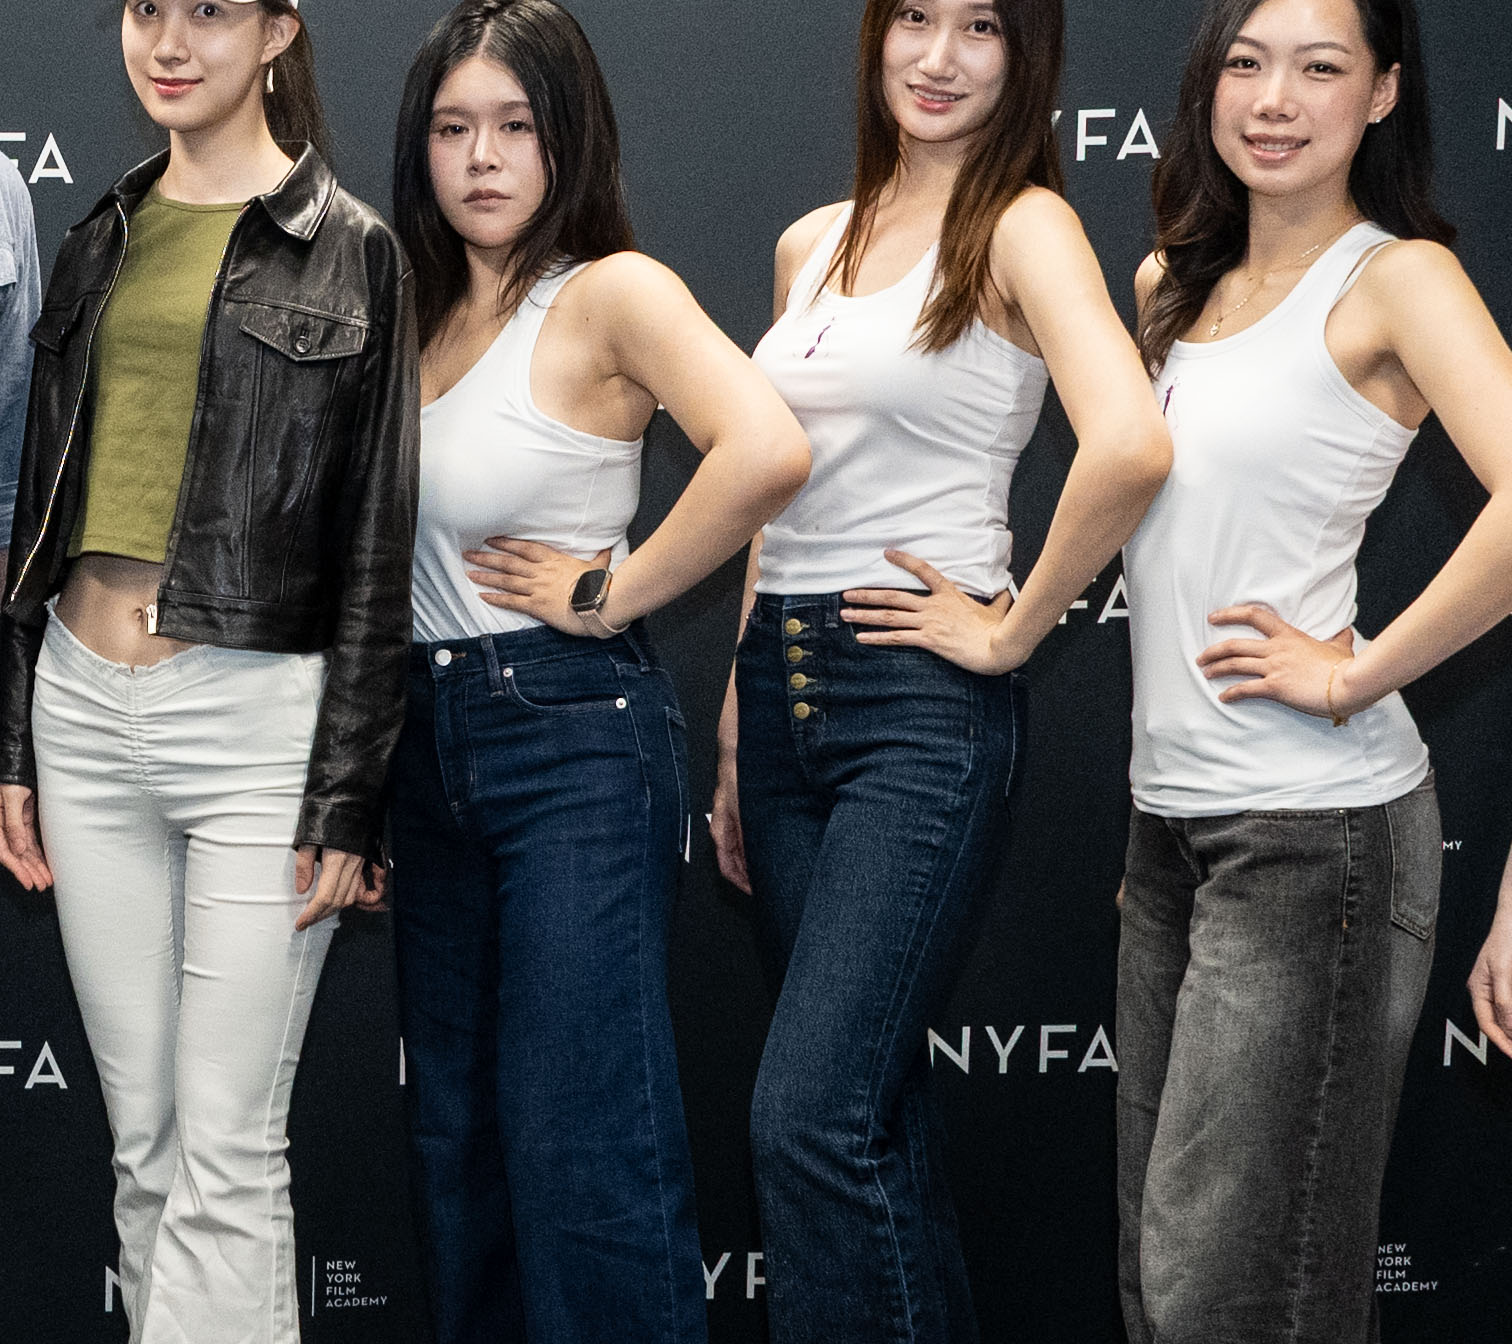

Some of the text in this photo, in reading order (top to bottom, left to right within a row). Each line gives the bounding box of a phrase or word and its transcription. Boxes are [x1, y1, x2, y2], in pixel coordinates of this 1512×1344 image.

[1050, 107, 1162, 162] FA
[927, 1023, 1120, 1075] NYFA
[1377, 1243, 1407, 1255] NEW
[326, 1260, 356, 1271] NEW
[1376, 1256, 1412, 1268] YORK
[325, 1272, 362, 1284] YORK
[1375, 1269, 1407, 1280] FILM
[325, 1286, 356, 1296] FILM
[1375, 1281, 1438, 1293] ACADEMY
[325, 1296, 388, 1308] ACADEMY
